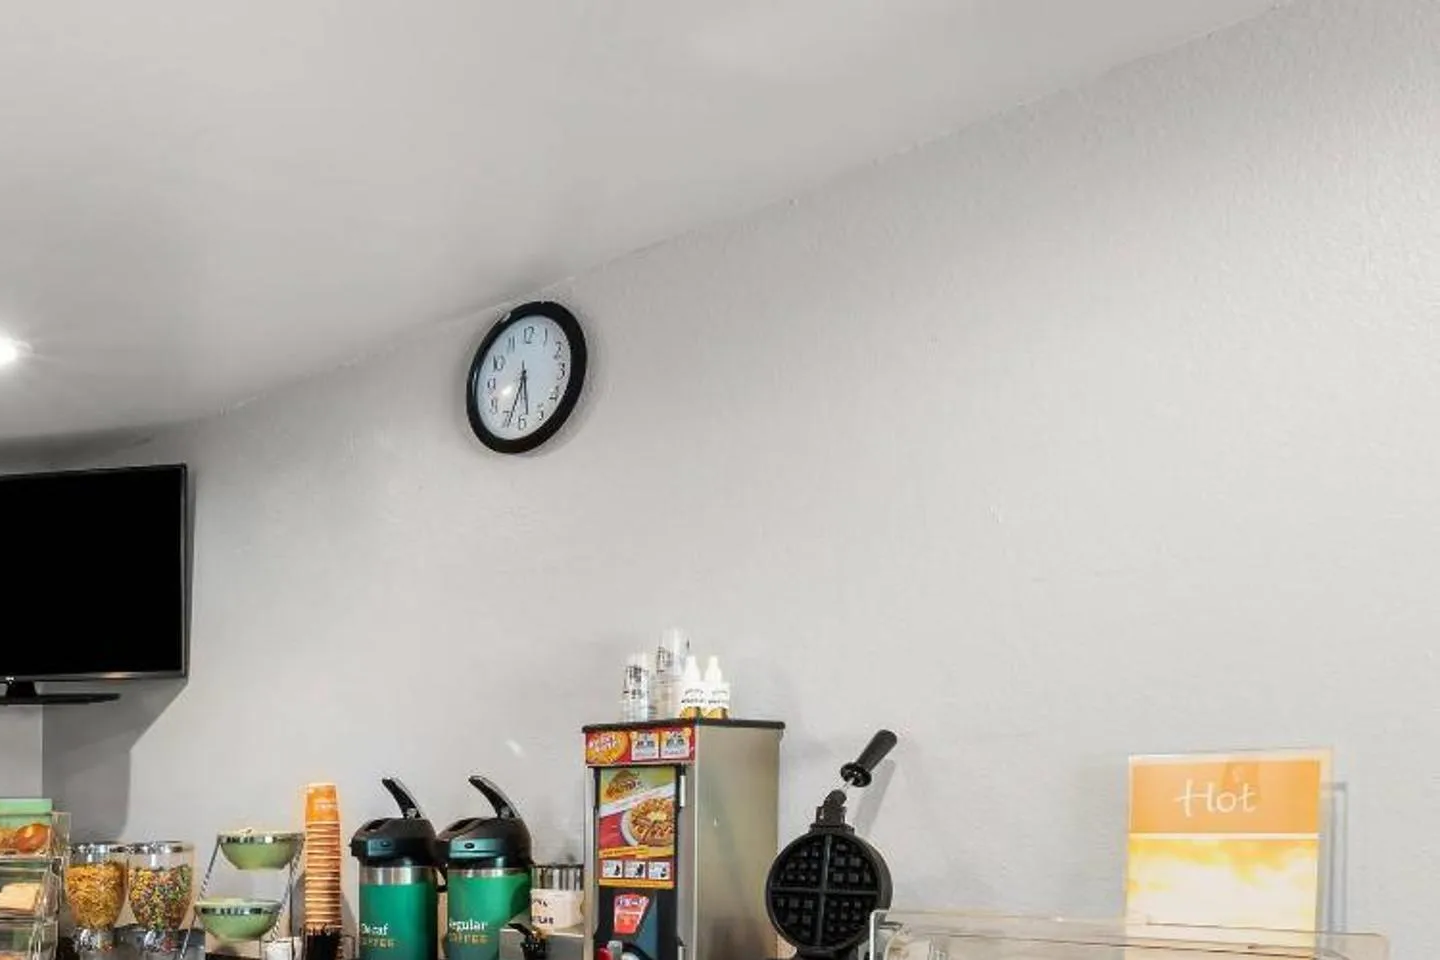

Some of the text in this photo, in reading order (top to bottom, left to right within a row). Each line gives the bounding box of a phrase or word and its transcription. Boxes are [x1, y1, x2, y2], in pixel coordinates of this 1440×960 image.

[523, 325, 536, 345] 12
[543, 327, 549, 348] 1
[508, 336, 516, 353] 11
[553, 341, 563, 361] 2
[492, 355, 506, 372] 10
[557, 362, 566, 381] 3
[486, 378, 497, 391] 9
[549, 386, 561, 402] 4
[490, 399, 499, 416] 8
[536, 402, 545, 421] 5
[502, 410, 512, 428] 7
[518, 415, 528, 431] 6
[1172, 779, 1258, 818] Hot
